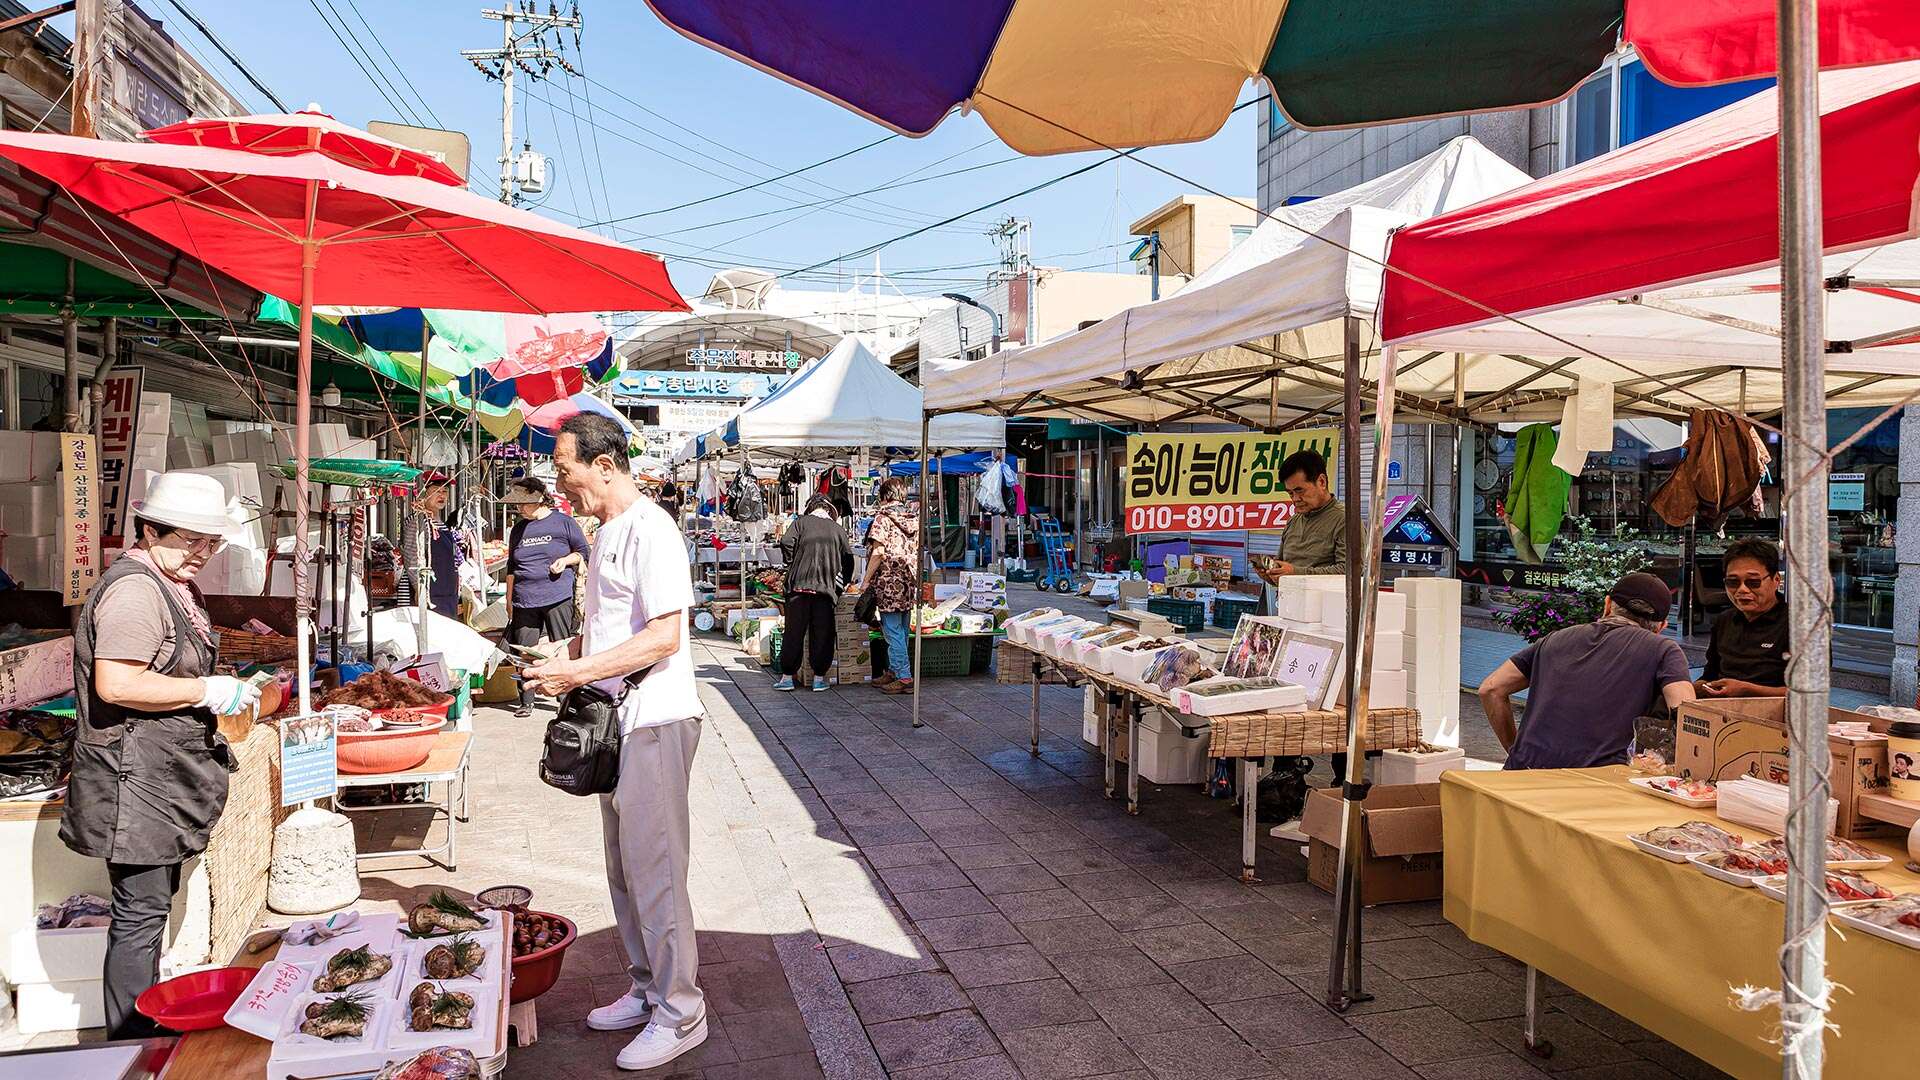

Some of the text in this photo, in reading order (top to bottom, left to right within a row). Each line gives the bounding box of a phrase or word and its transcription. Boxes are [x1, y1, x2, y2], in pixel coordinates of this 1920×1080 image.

[72, 440, 87, 471] 강원도
[1389, 550, 1433, 564] 정명사
[1400, 862, 1431, 873] FRESH
